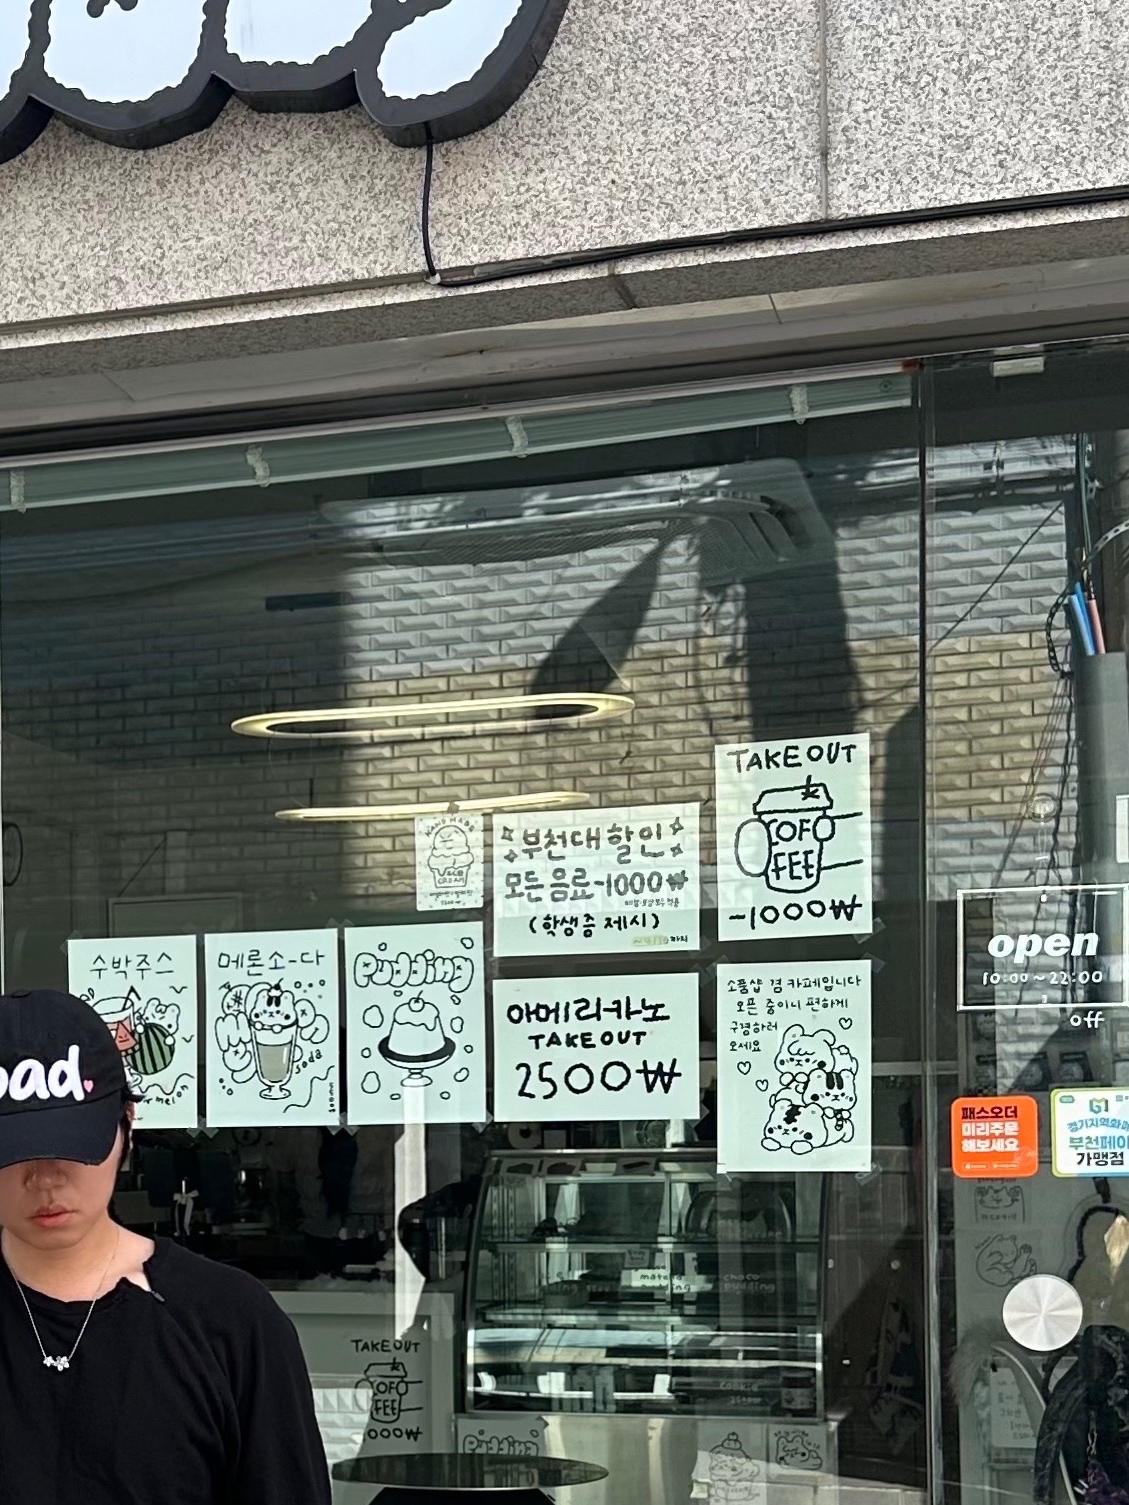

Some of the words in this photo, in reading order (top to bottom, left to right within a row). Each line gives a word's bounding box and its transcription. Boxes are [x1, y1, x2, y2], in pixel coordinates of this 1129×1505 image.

[988, 932, 1099, 964] open
[90, 952, 174, 980] 수박주스
[982, 971, 1028, 985] 10:00
[1049, 971, 1103, 985] 22:00
[507, 996, 670, 1024] 아메리카노
[1070, 1011, 1105, 1028] off
[729, 1040, 761, 1052] 오세요
[295, 1049, 323, 1074] soda
[961, 1106, 1018, 1120] 패스오더
[961, 1121, 1019, 1137] 미리주문
[961, 1138, 1019, 1152] 해보세요
[1076, 1151, 1124, 1166] 가맹점
